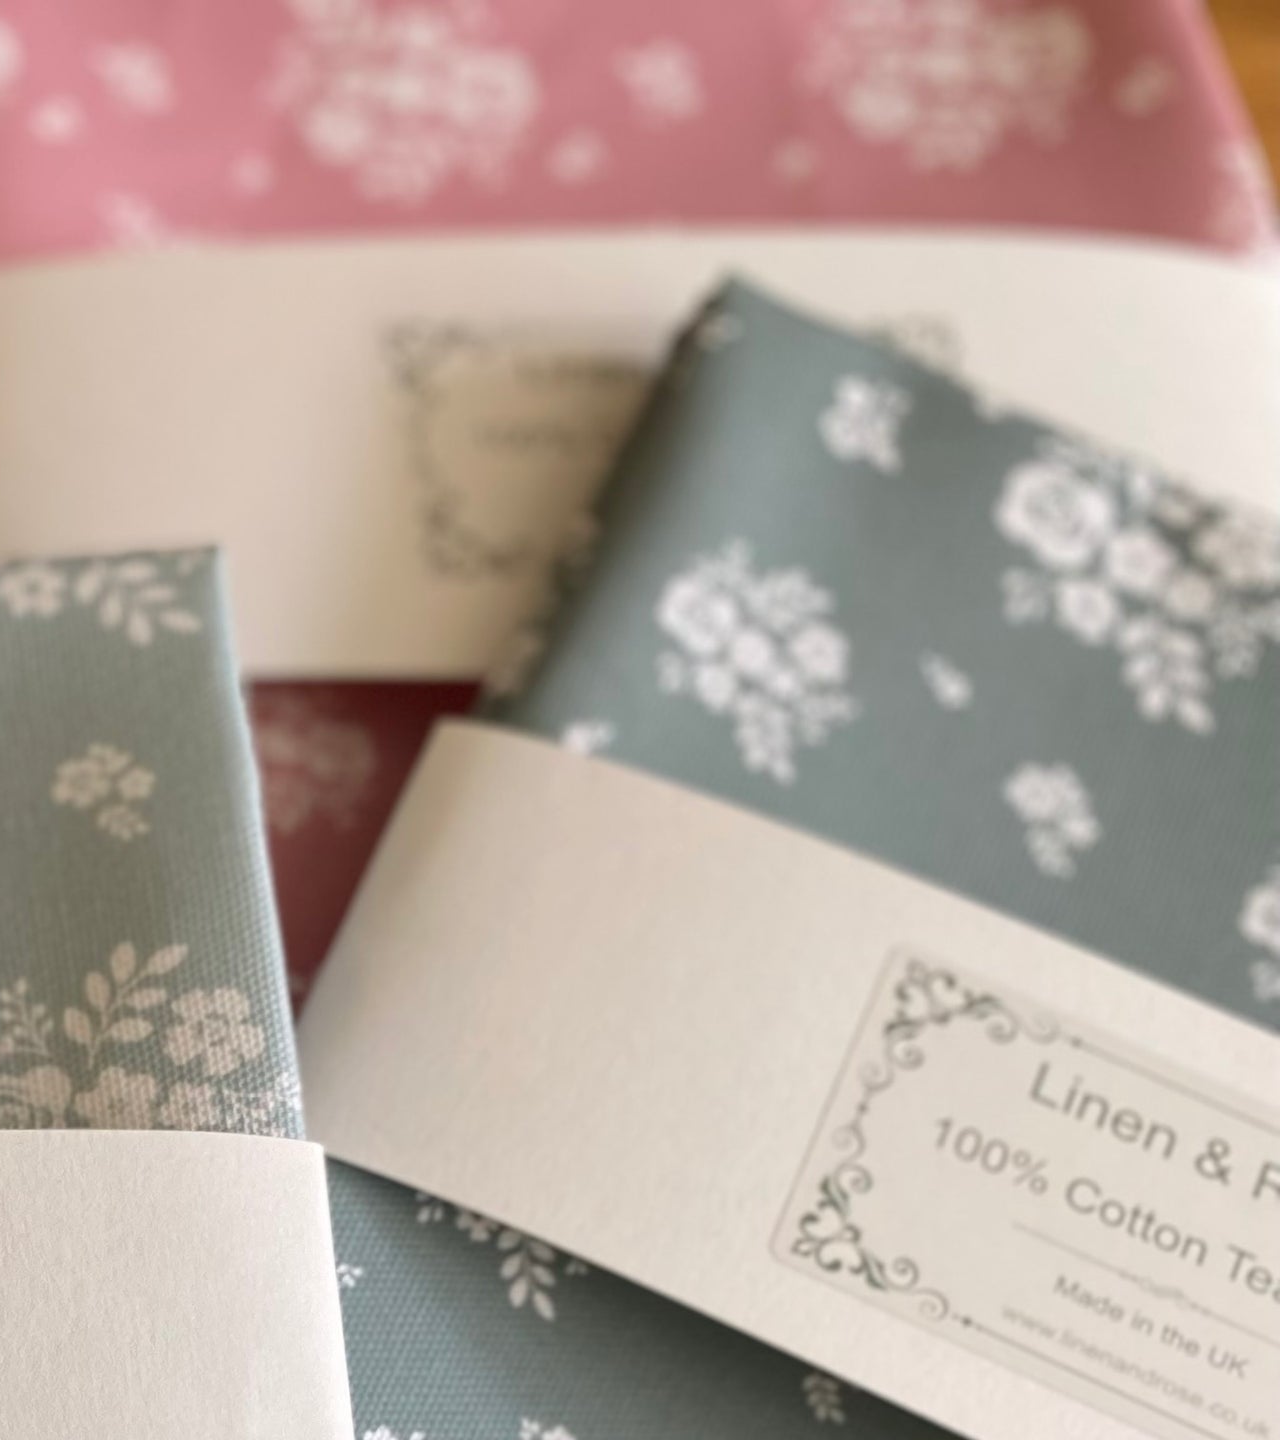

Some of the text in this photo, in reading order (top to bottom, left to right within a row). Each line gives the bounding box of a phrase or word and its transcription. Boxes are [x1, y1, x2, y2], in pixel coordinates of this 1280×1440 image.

[1029, 1060, 1178, 1162] Linen
[1193, 1136, 1232, 1187] &
[934, 1116, 1050, 1198] 100%
[1064, 1175, 1208, 1267] Cotton
[1052, 1273, 1251, 1380] Made in the UK
